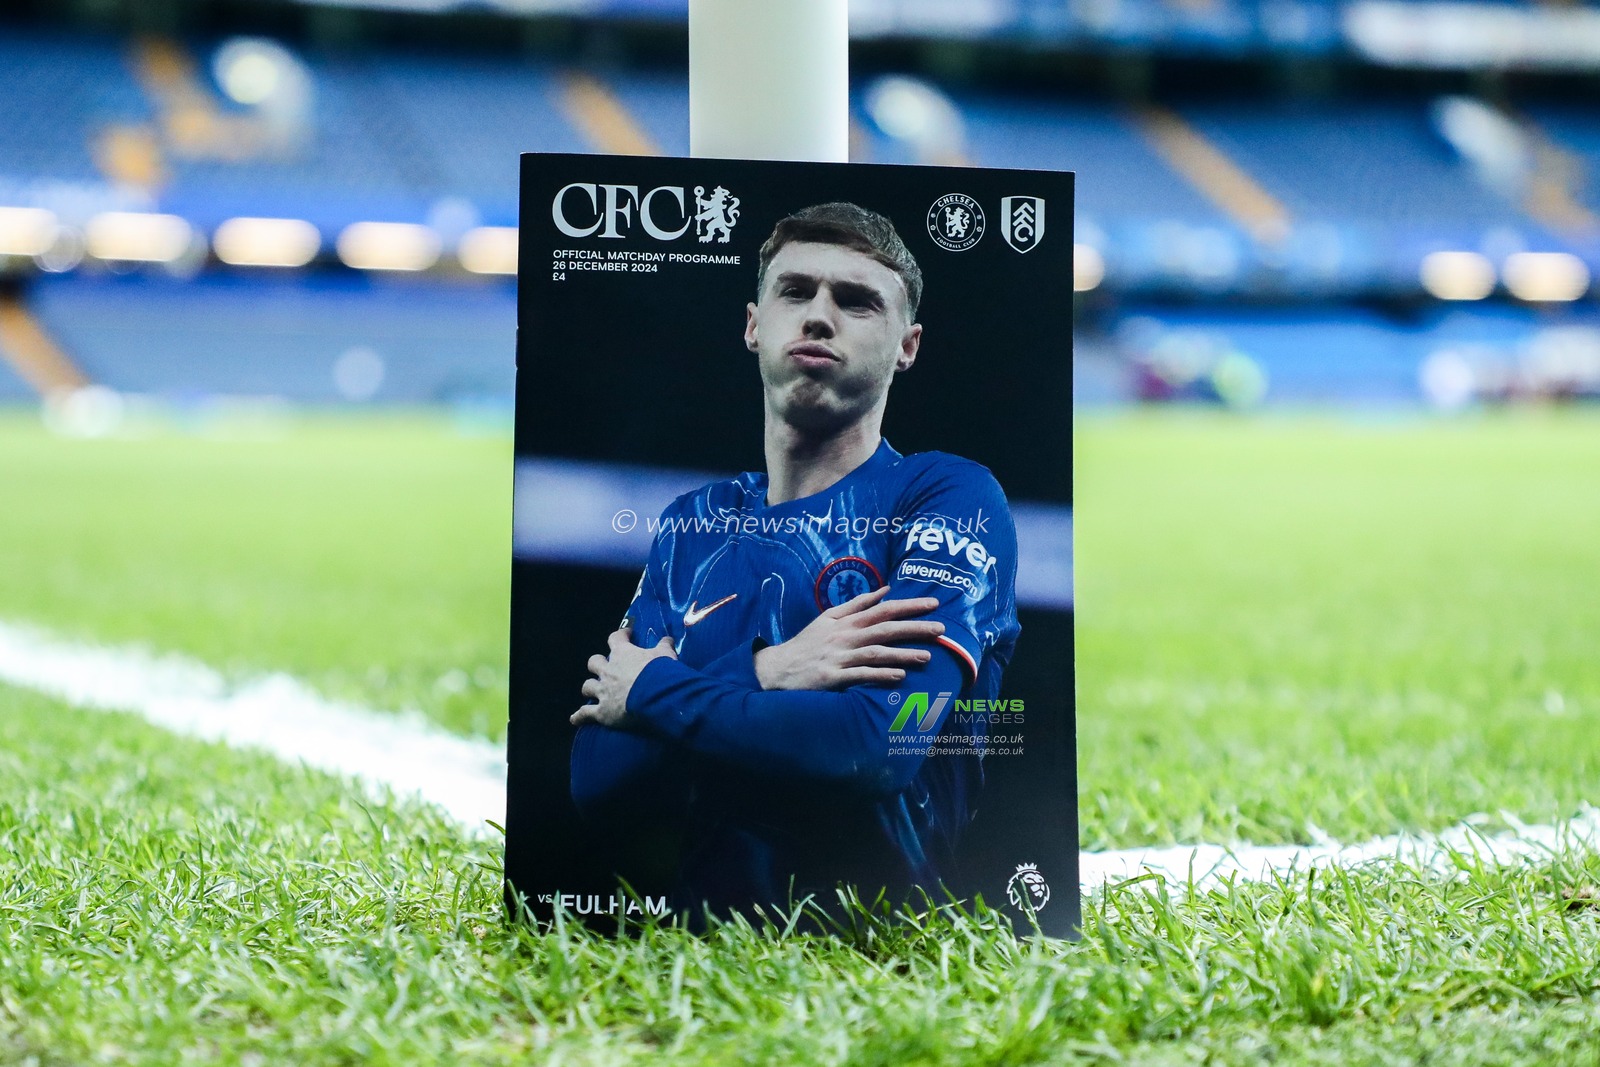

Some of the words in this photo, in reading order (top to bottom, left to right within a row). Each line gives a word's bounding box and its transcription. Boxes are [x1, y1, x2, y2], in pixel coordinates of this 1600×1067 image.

[937, 196, 975, 209] CHELSEA
[552, 182, 691, 240] CFC
[937, 237, 961, 248] FOOTBALL
[553, 250, 604, 260] OFFICIAL
[607, 251, 667, 262] MATCHDAY
[669, 253, 741, 265] PROGRAMME
[553, 261, 566, 270] 26
[569, 261, 629, 272] DECEMBER
[631, 263, 658, 273] 2024
[553, 272, 566, 281] £4
[904, 523, 997, 574] fever
[901, 562, 979, 597] feverup.com
[560, 894, 666, 915] FULHAM
